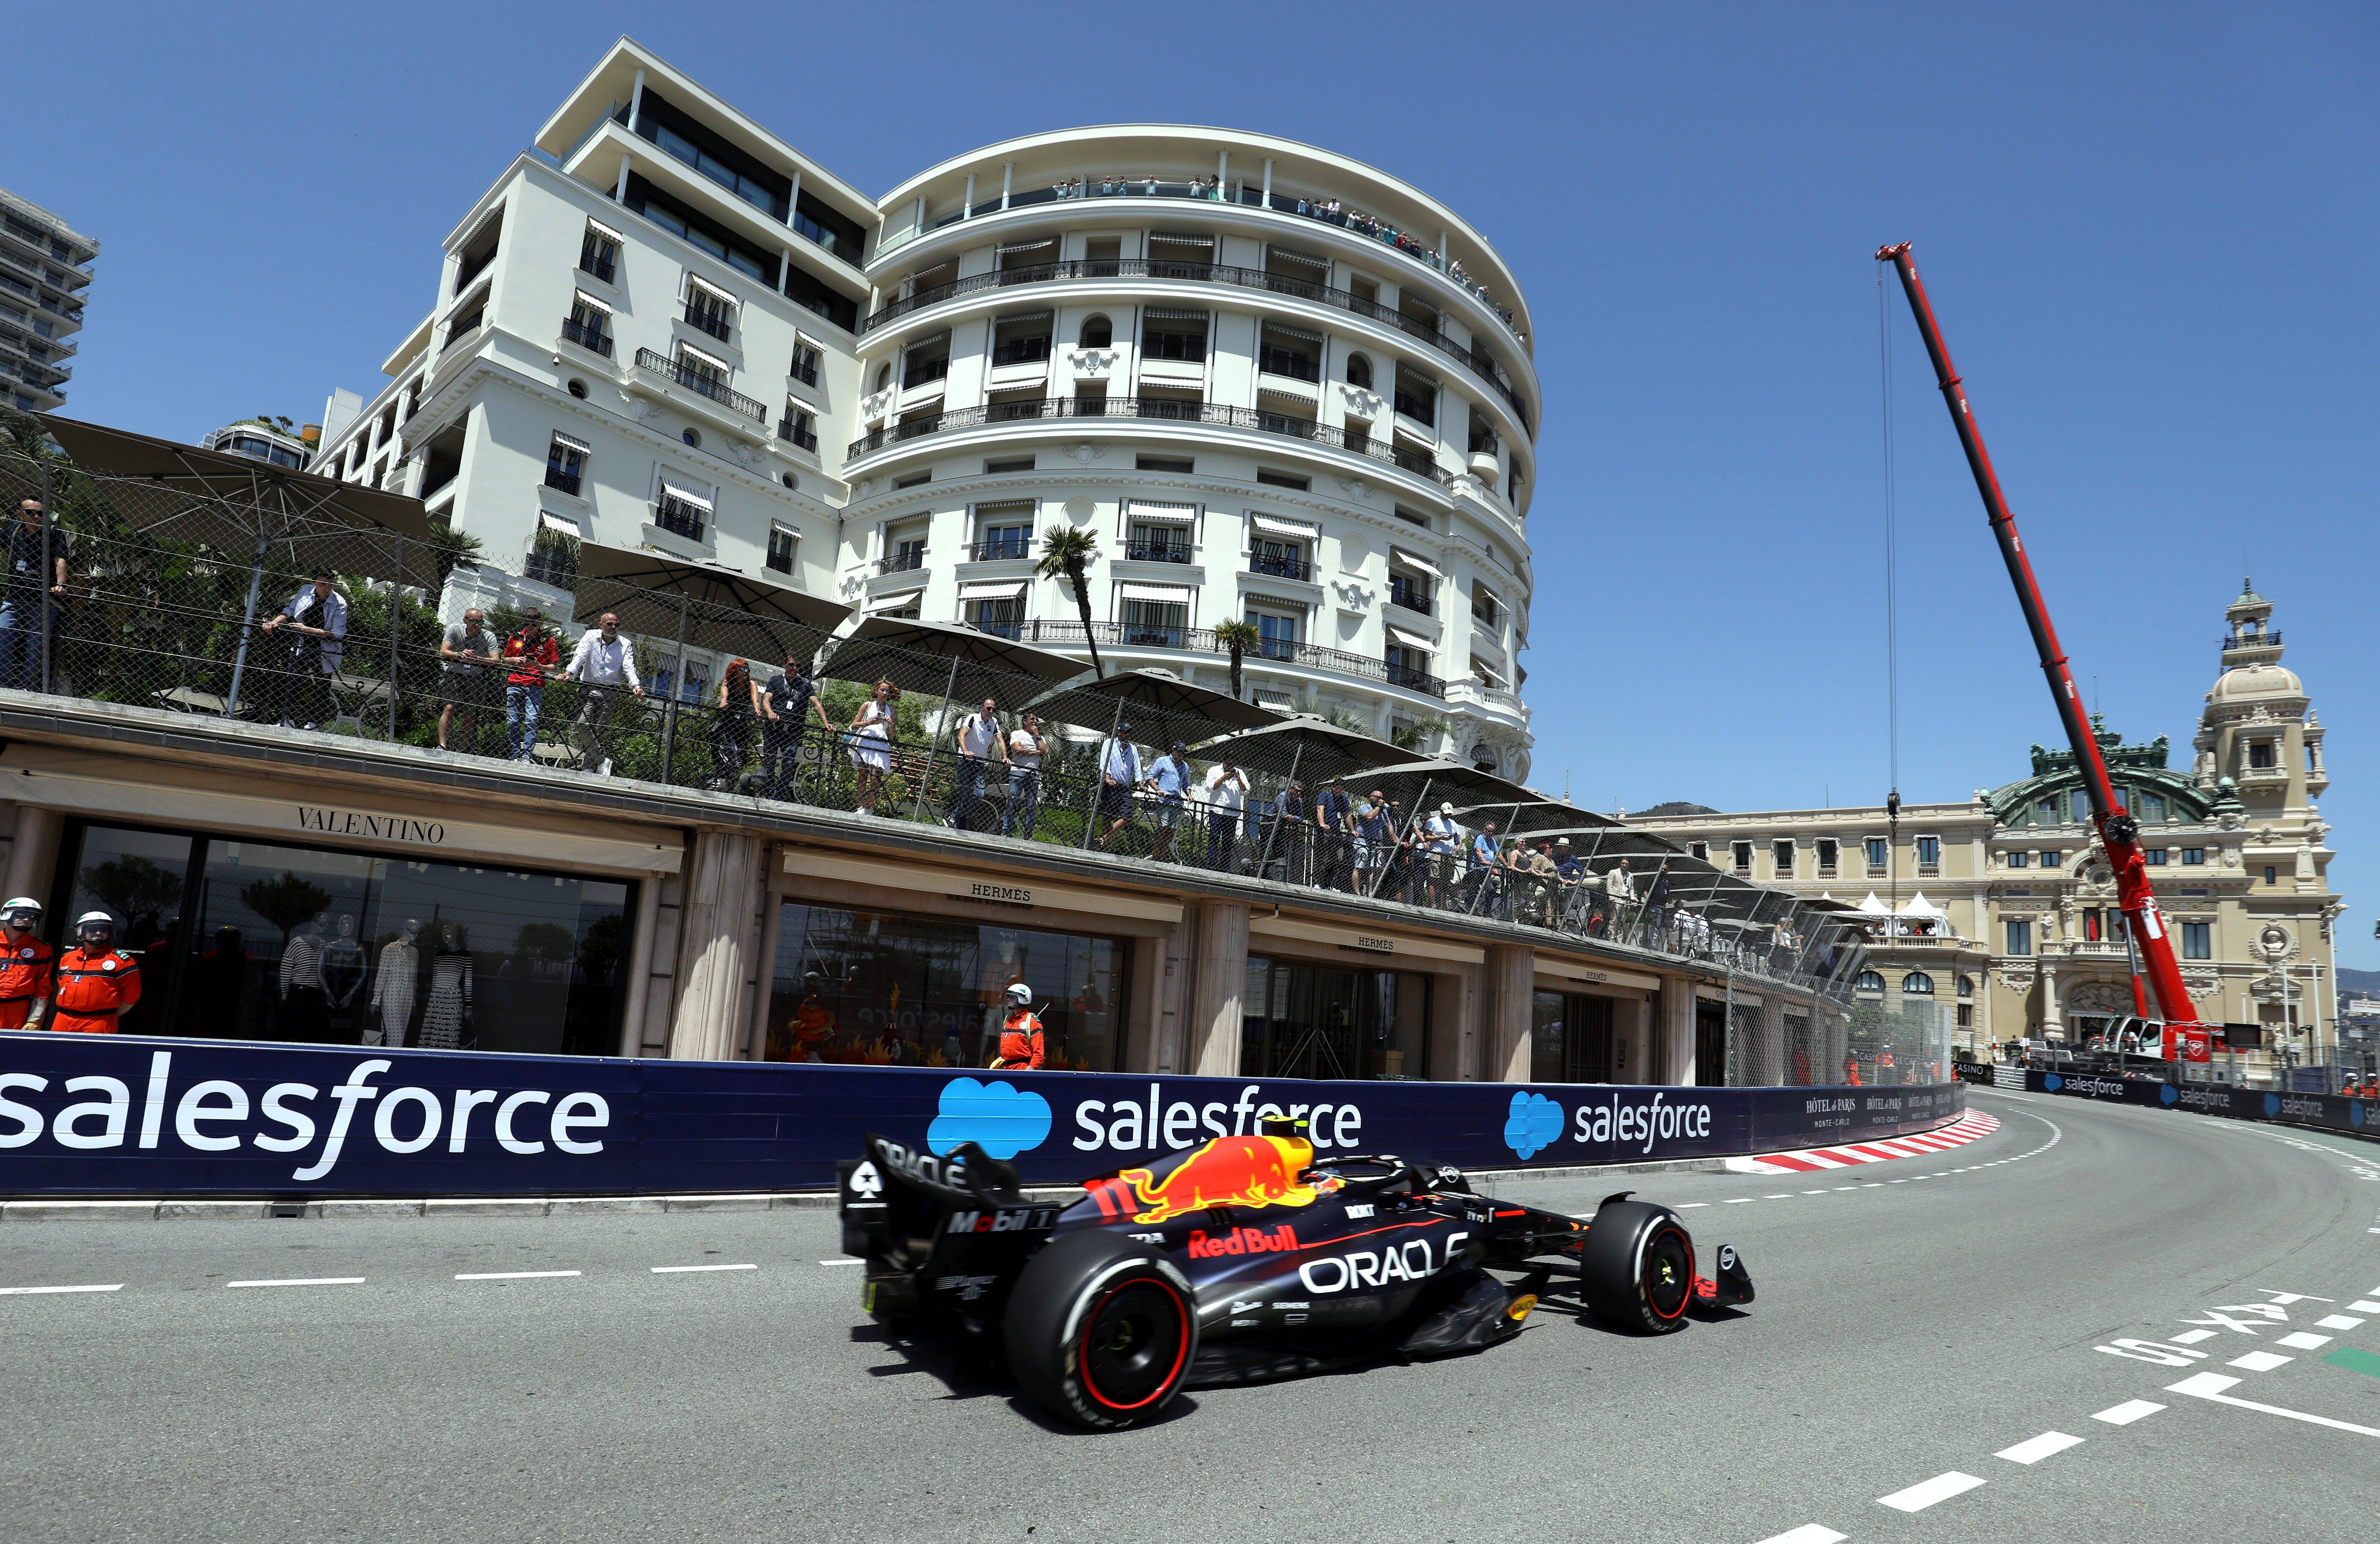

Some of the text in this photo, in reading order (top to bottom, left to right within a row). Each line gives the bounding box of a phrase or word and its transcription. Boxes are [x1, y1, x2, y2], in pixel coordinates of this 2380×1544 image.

[298, 807, 444, 844] VALENTINO
[971, 884, 1030, 902] HERMÈS
[1359, 937, 1393, 950] HERMÈS
[1586, 971, 1607, 981] HERMÈS
[2065, 1076, 2123, 1096] salesforce
[1806, 1097, 1831, 1113] HÔTEL
[1838, 1098, 1855, 1112] PARIS
[1867, 1096, 1885, 1110] HÔTEL
[2180, 1087, 2230, 1110] salesforce
[2282, 1095, 2323, 1121] salesforce
[0, 1052, 609, 1180] salesforce
[1575, 1093, 1710, 1153] salesforce
[1815, 1118, 1850, 1128] MONTE-CARLO
[946, 1210, 1031, 1233] Mobil
